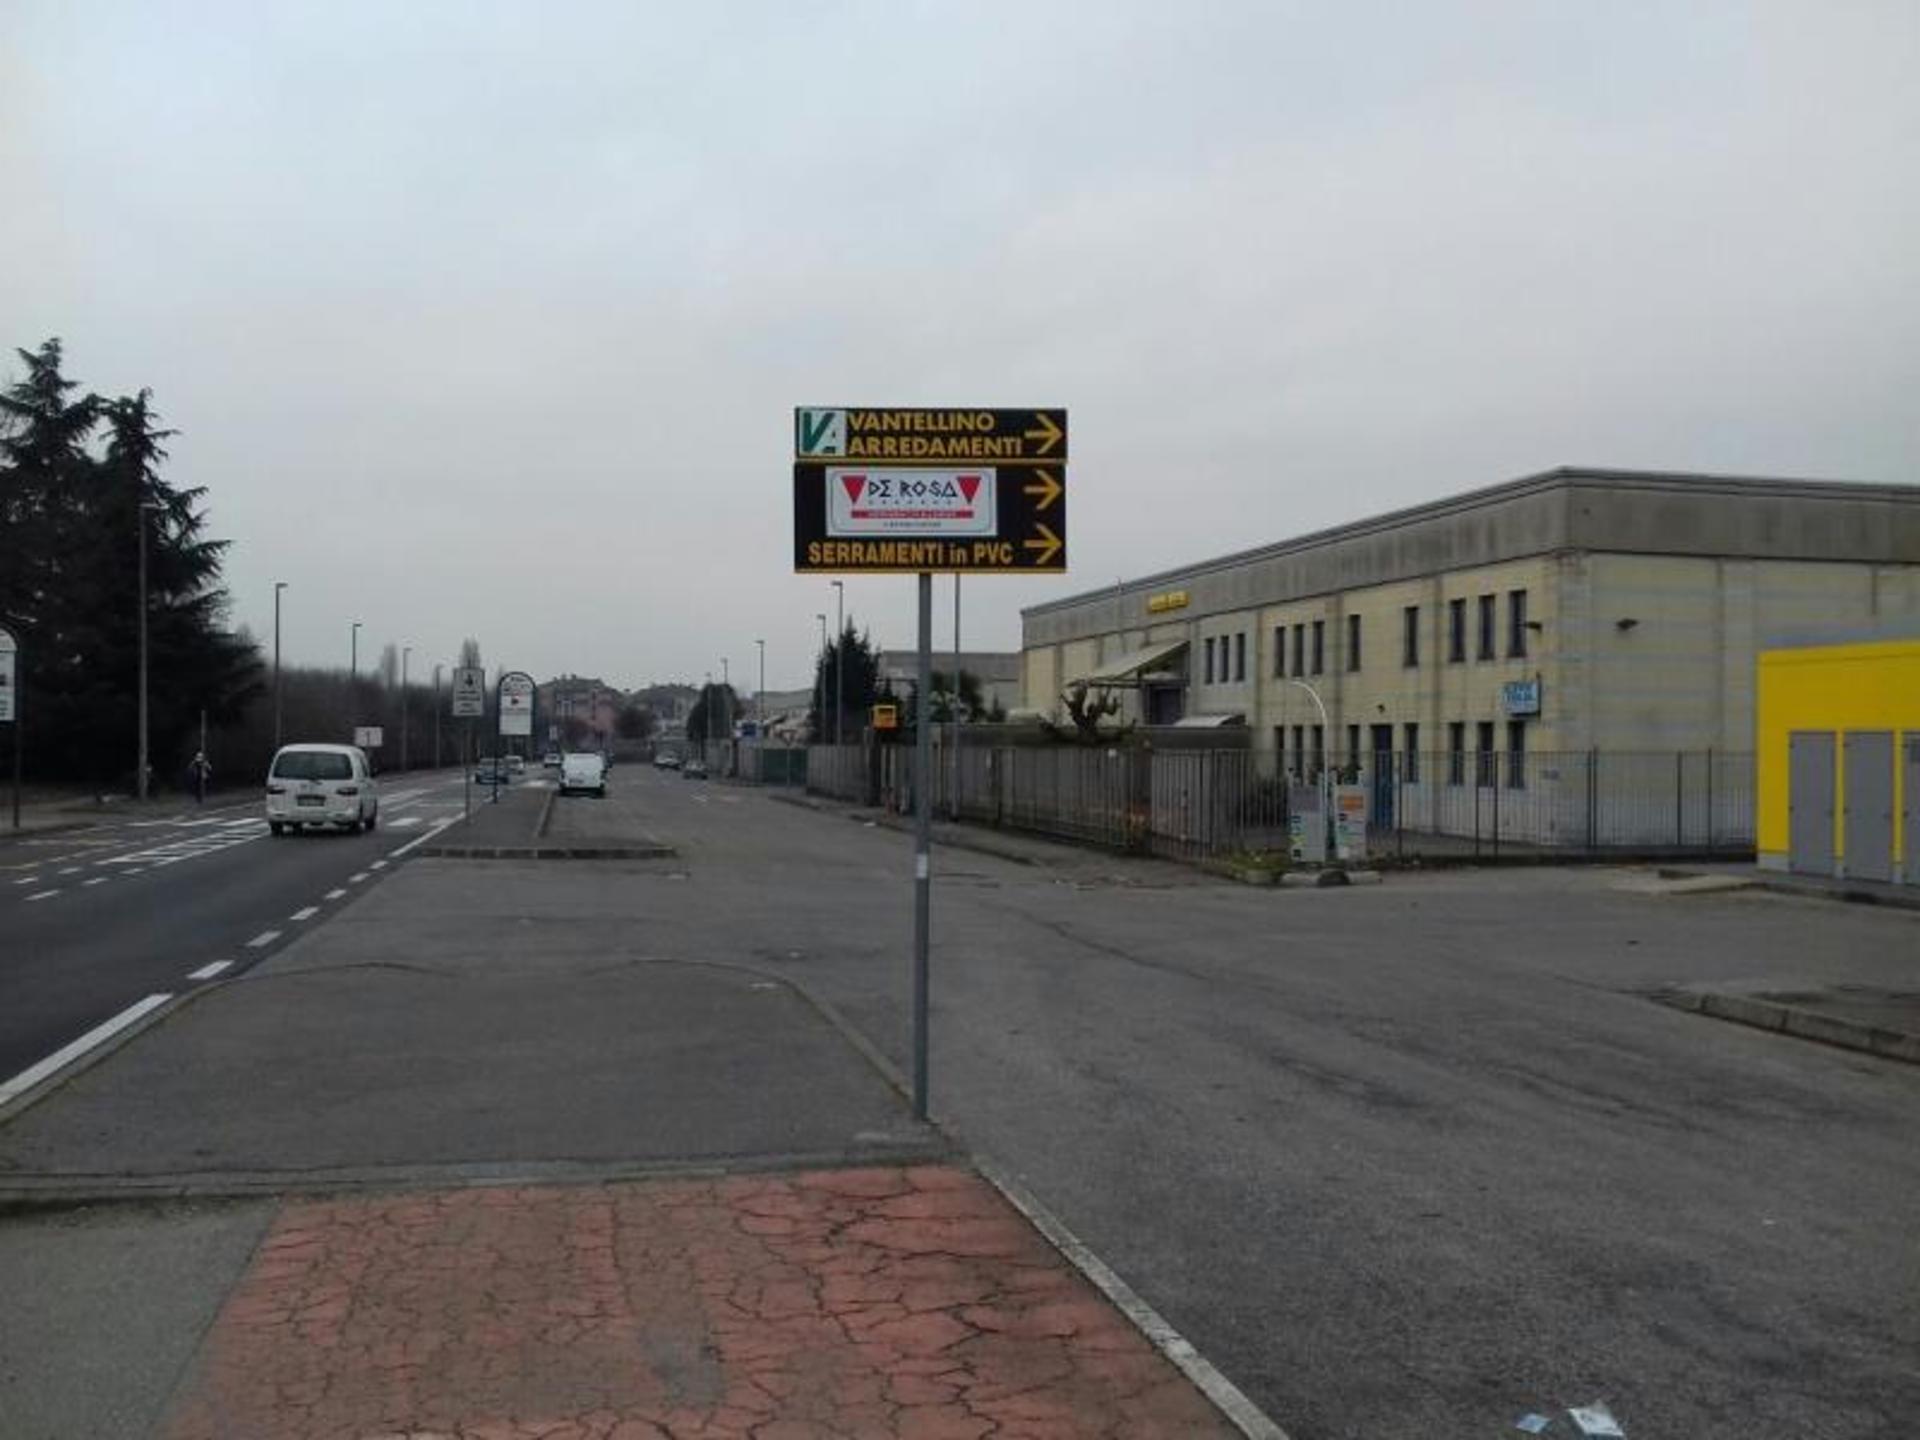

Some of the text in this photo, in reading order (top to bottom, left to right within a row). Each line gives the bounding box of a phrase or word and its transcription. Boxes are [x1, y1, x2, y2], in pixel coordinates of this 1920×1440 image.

[849, 412, 995, 431] VANTELLINO
[849, 436, 1022, 455] ARREDAMENTI
[868, 479, 958, 498] DE ROSA
[808, 542, 1013, 564] SERRAMENTI in PVC
